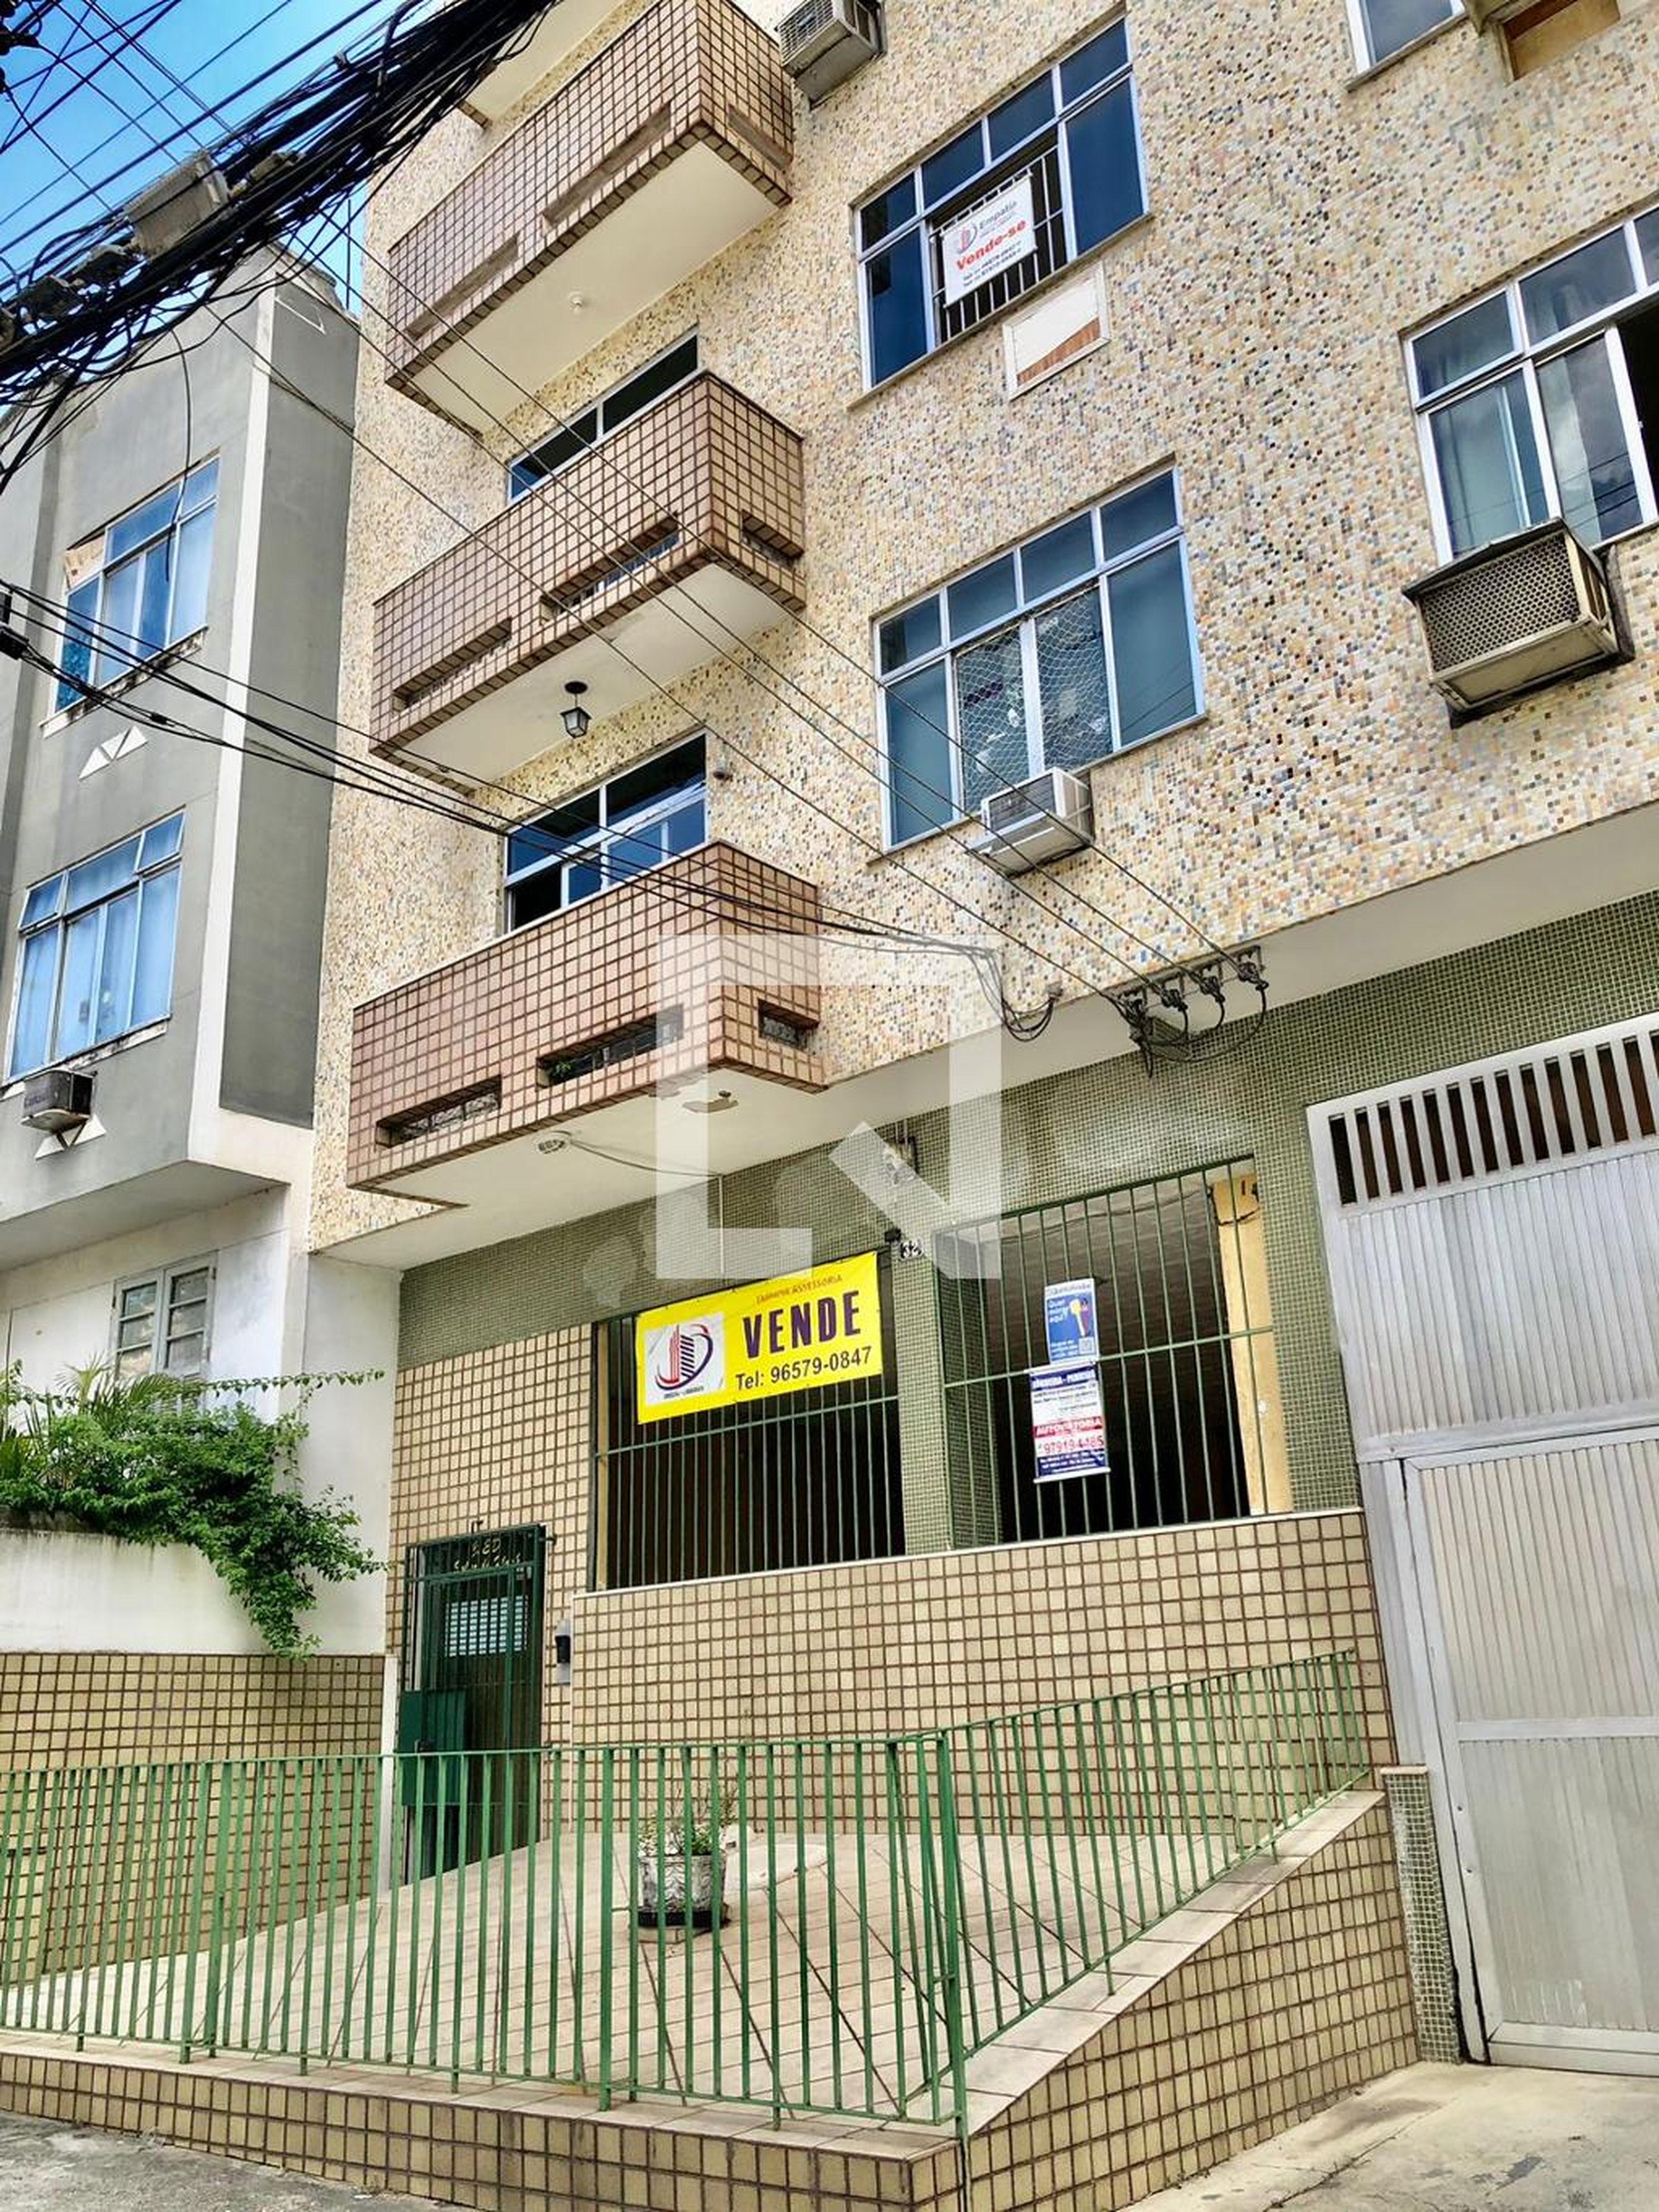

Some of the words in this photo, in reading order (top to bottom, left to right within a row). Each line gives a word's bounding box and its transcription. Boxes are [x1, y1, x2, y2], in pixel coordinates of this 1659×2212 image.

[957, 220, 1026, 270] Vende-se
[742, 1290, 861, 1359] VENDE
[735, 1370, 764, 1391] Tel:
[770, 1345, 872, 1384] 96579-0847
